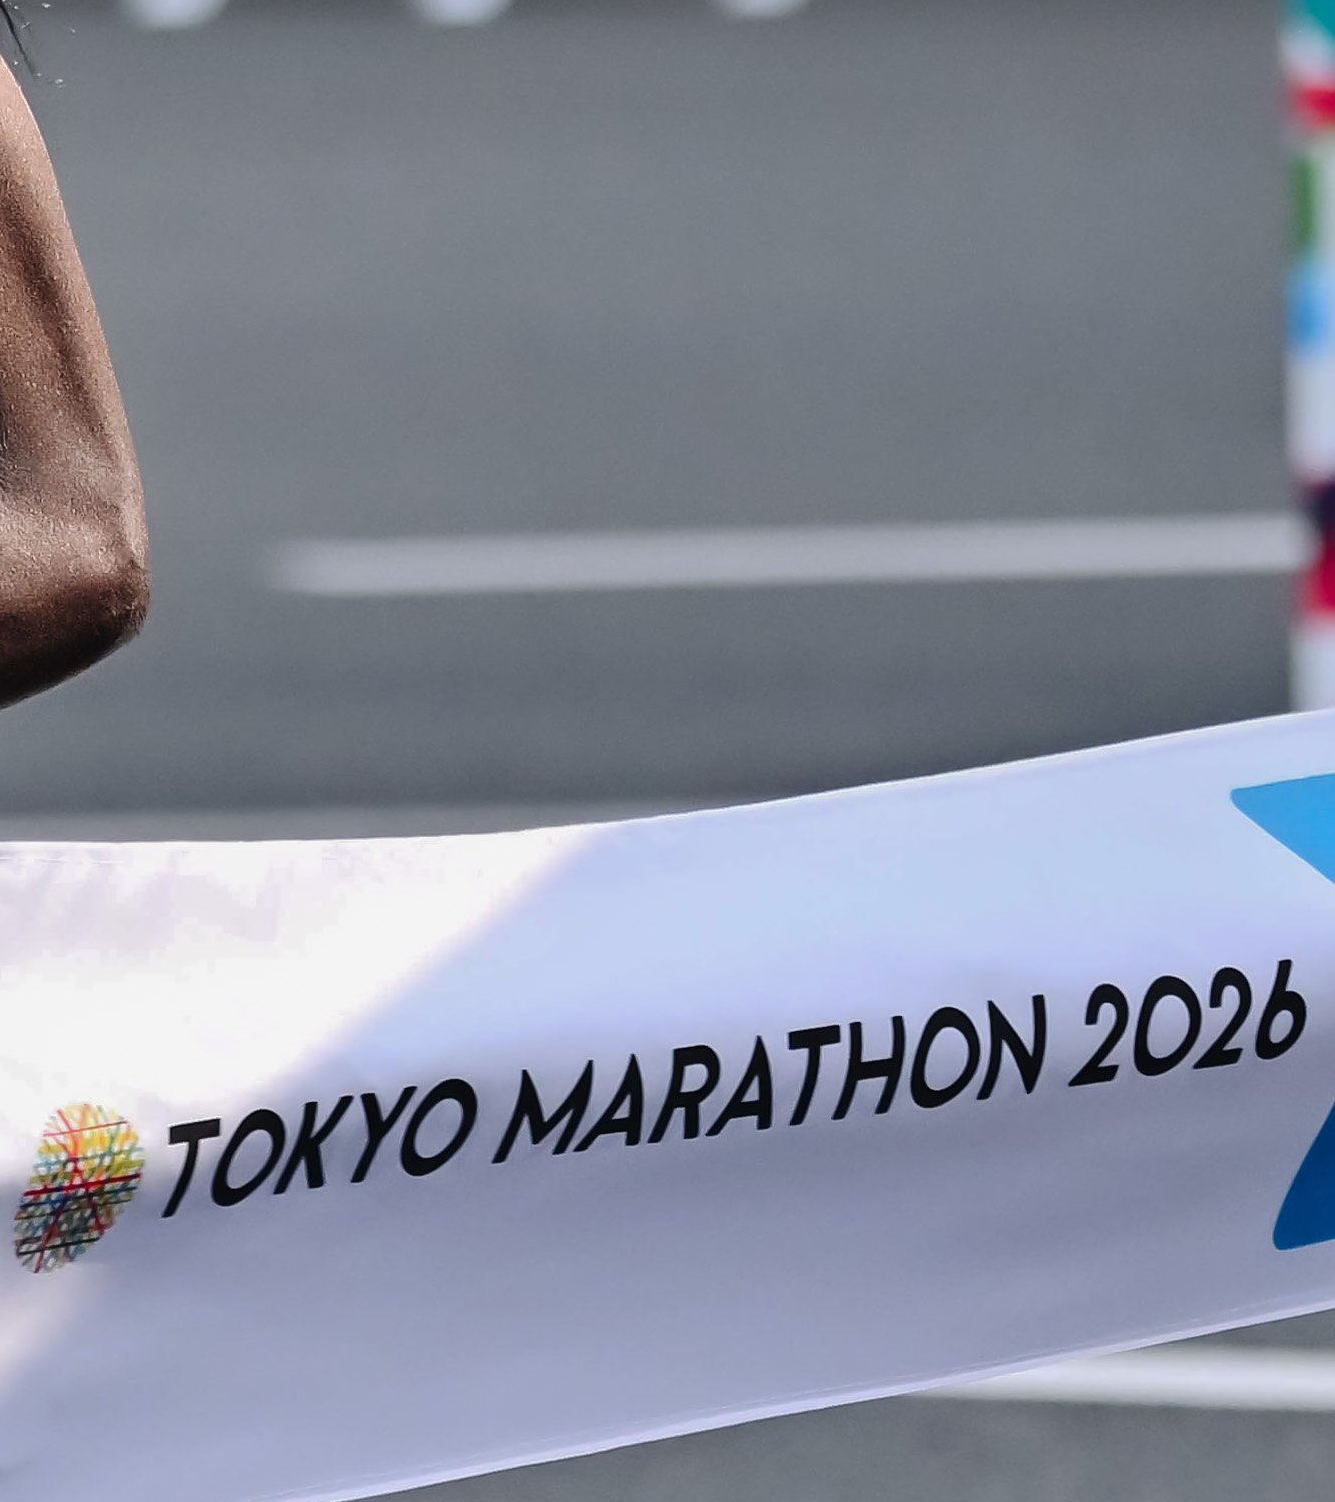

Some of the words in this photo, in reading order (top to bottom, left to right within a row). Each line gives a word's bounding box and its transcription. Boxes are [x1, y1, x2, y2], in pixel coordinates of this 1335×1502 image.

[161, 1076, 478, 1219] TOKYO
[491, 992, 1049, 1166] MARATHON
[1067, 957, 1309, 1089] 2026
